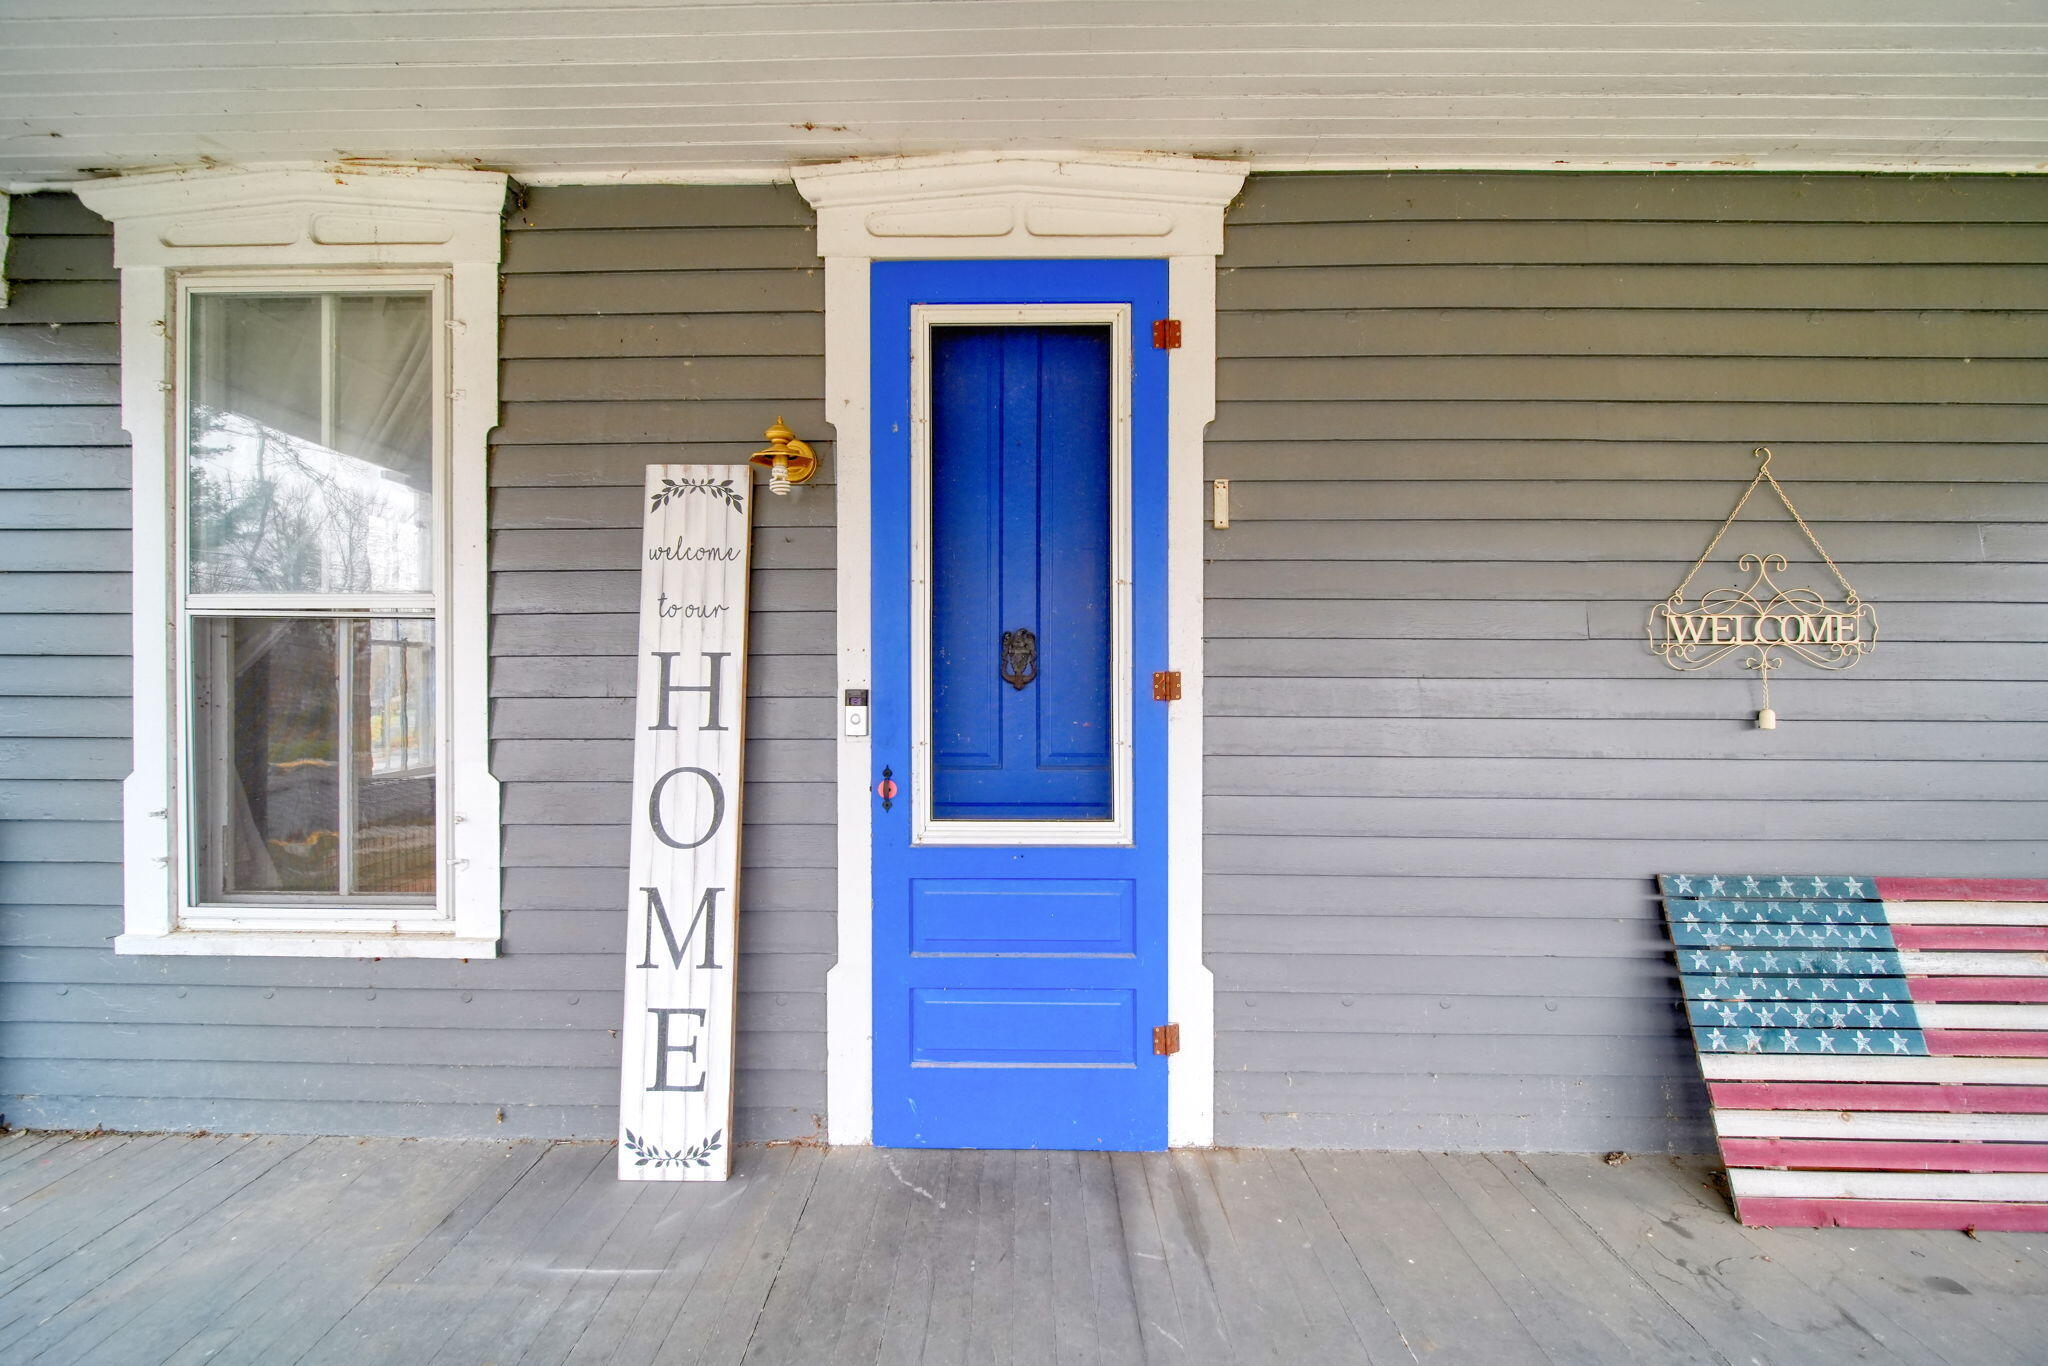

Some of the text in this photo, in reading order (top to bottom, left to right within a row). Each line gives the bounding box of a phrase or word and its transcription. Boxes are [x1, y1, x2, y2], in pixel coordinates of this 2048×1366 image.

[649, 536, 741, 562] welcome
[658, 592, 730, 619] to our
[1667, 615, 1860, 644] WELCOME
[635, 651, 732, 1092] HOME
